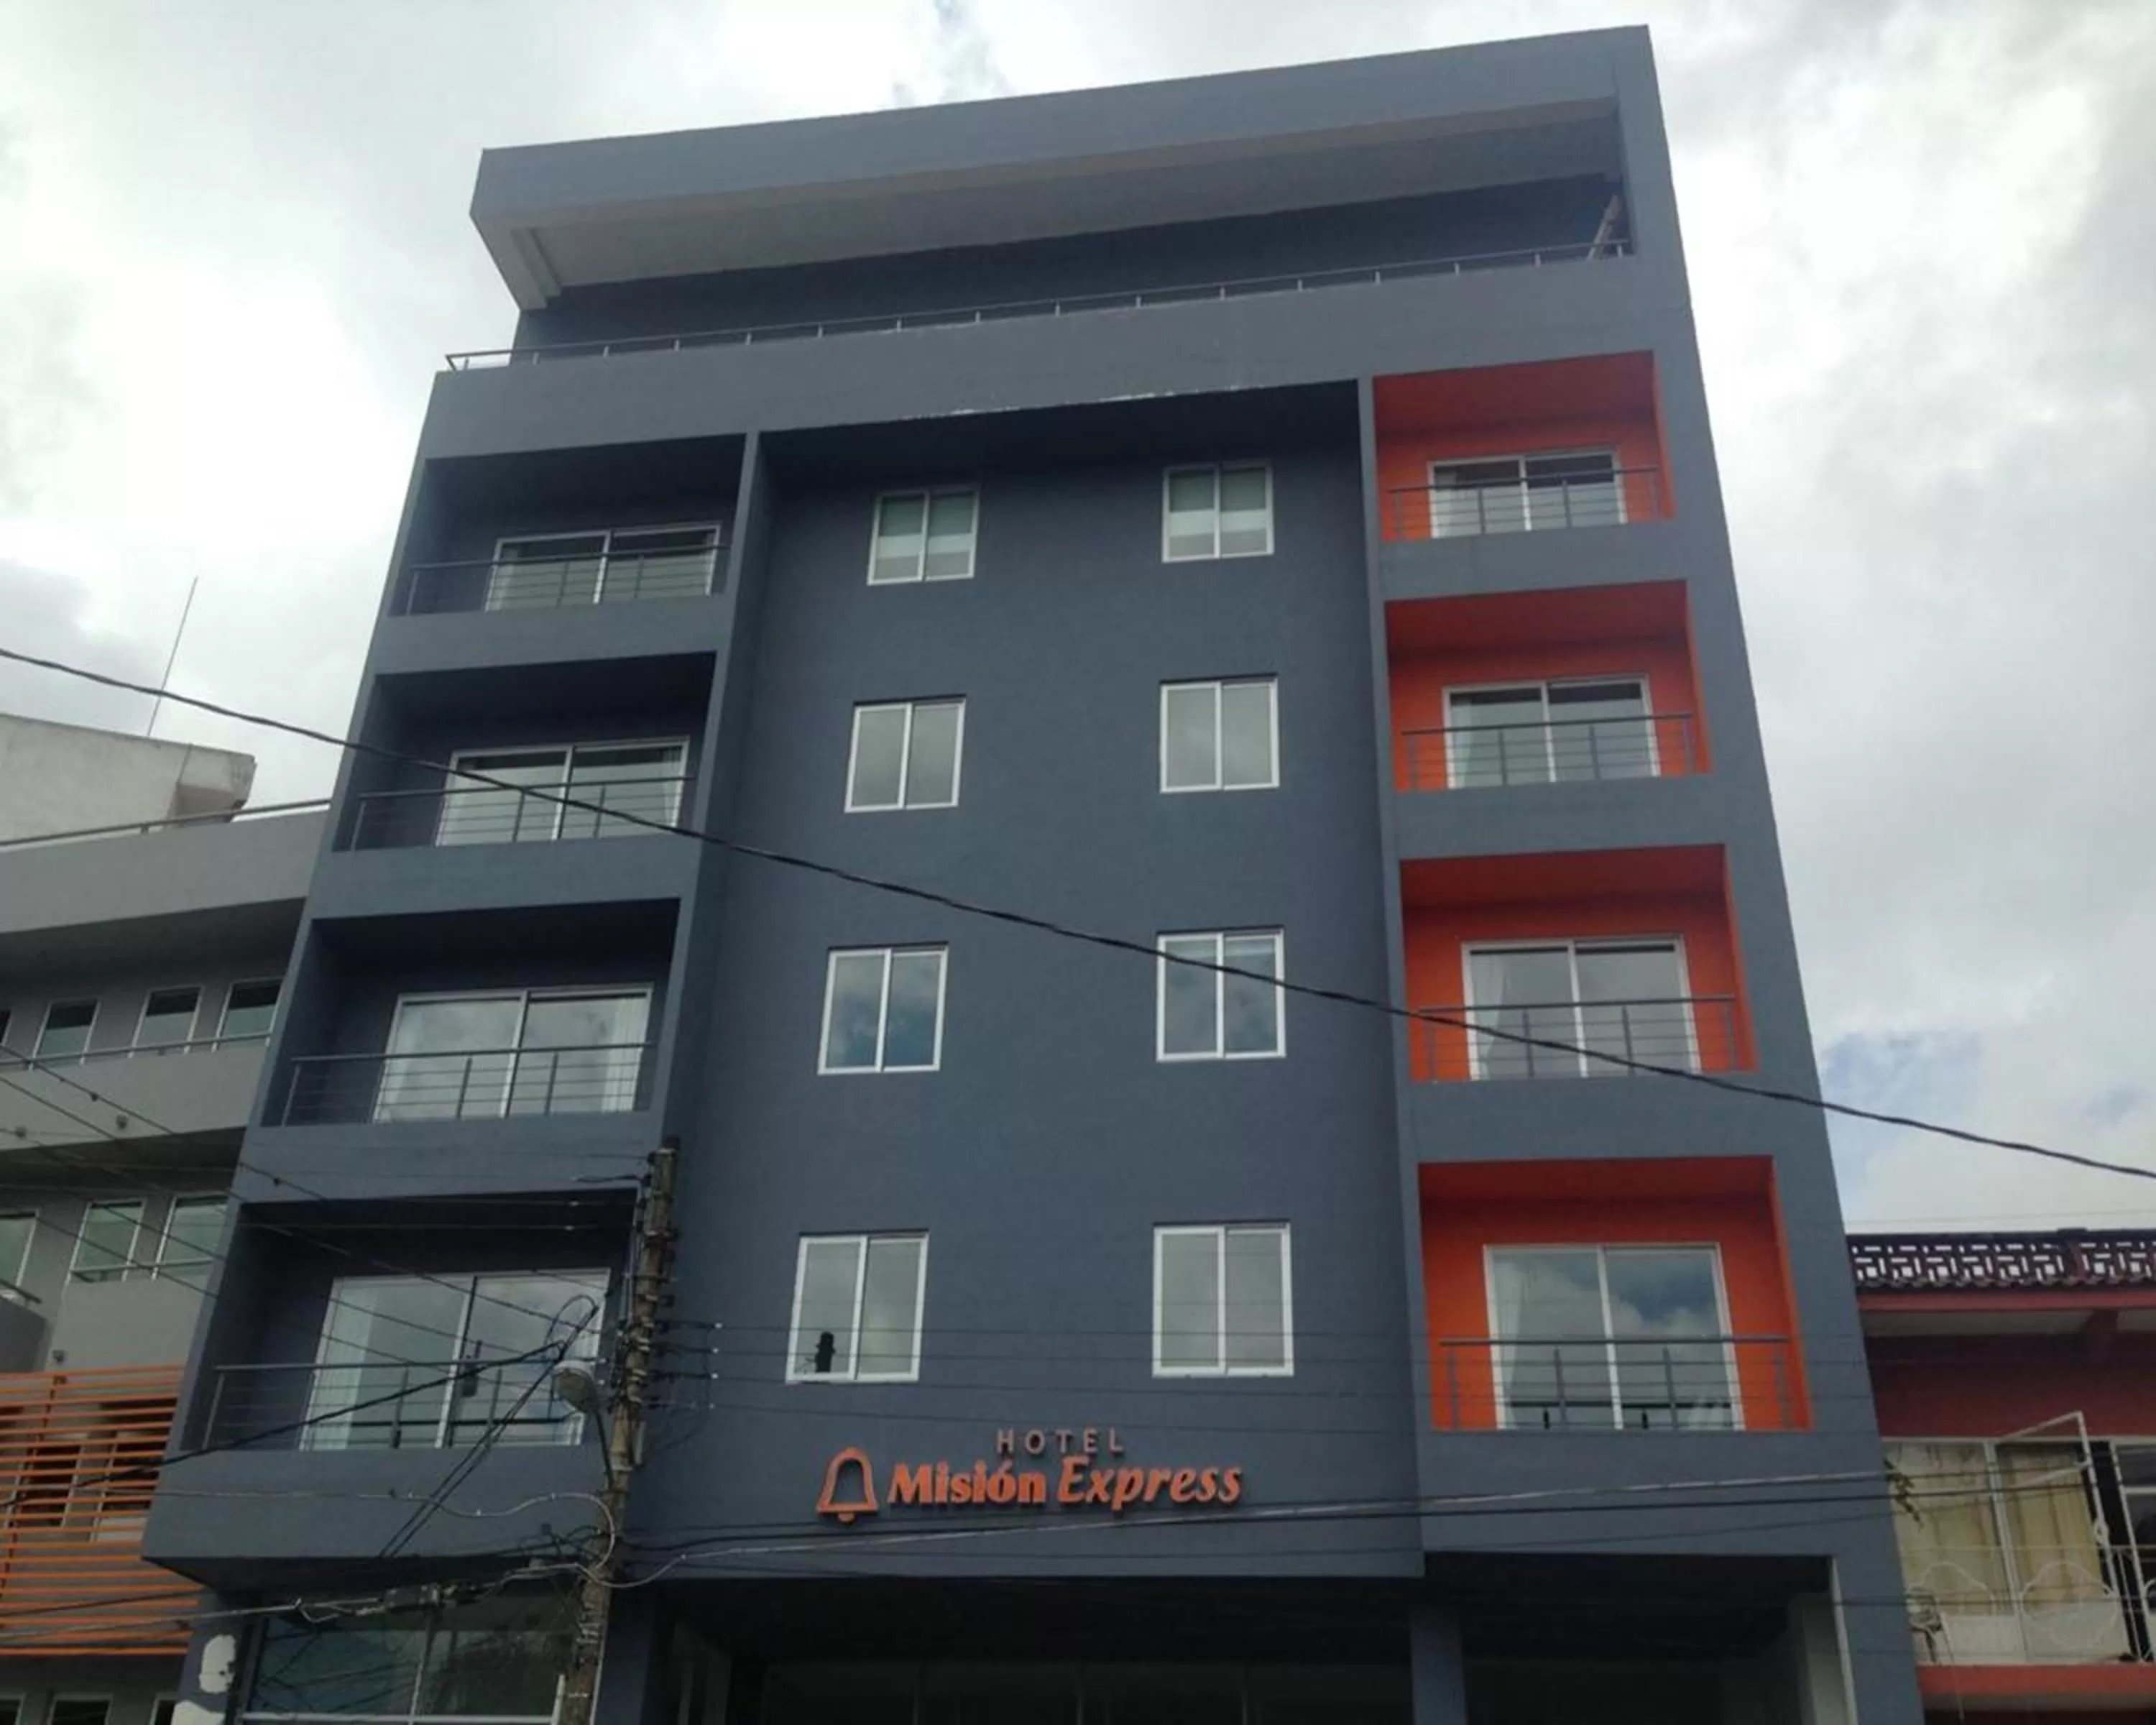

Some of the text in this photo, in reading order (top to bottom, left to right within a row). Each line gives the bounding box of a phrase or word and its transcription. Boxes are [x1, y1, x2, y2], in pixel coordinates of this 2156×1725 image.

[996, 1427, 1125, 1453] HOTEL
[888, 1455, 1243, 1511] Misión Express
